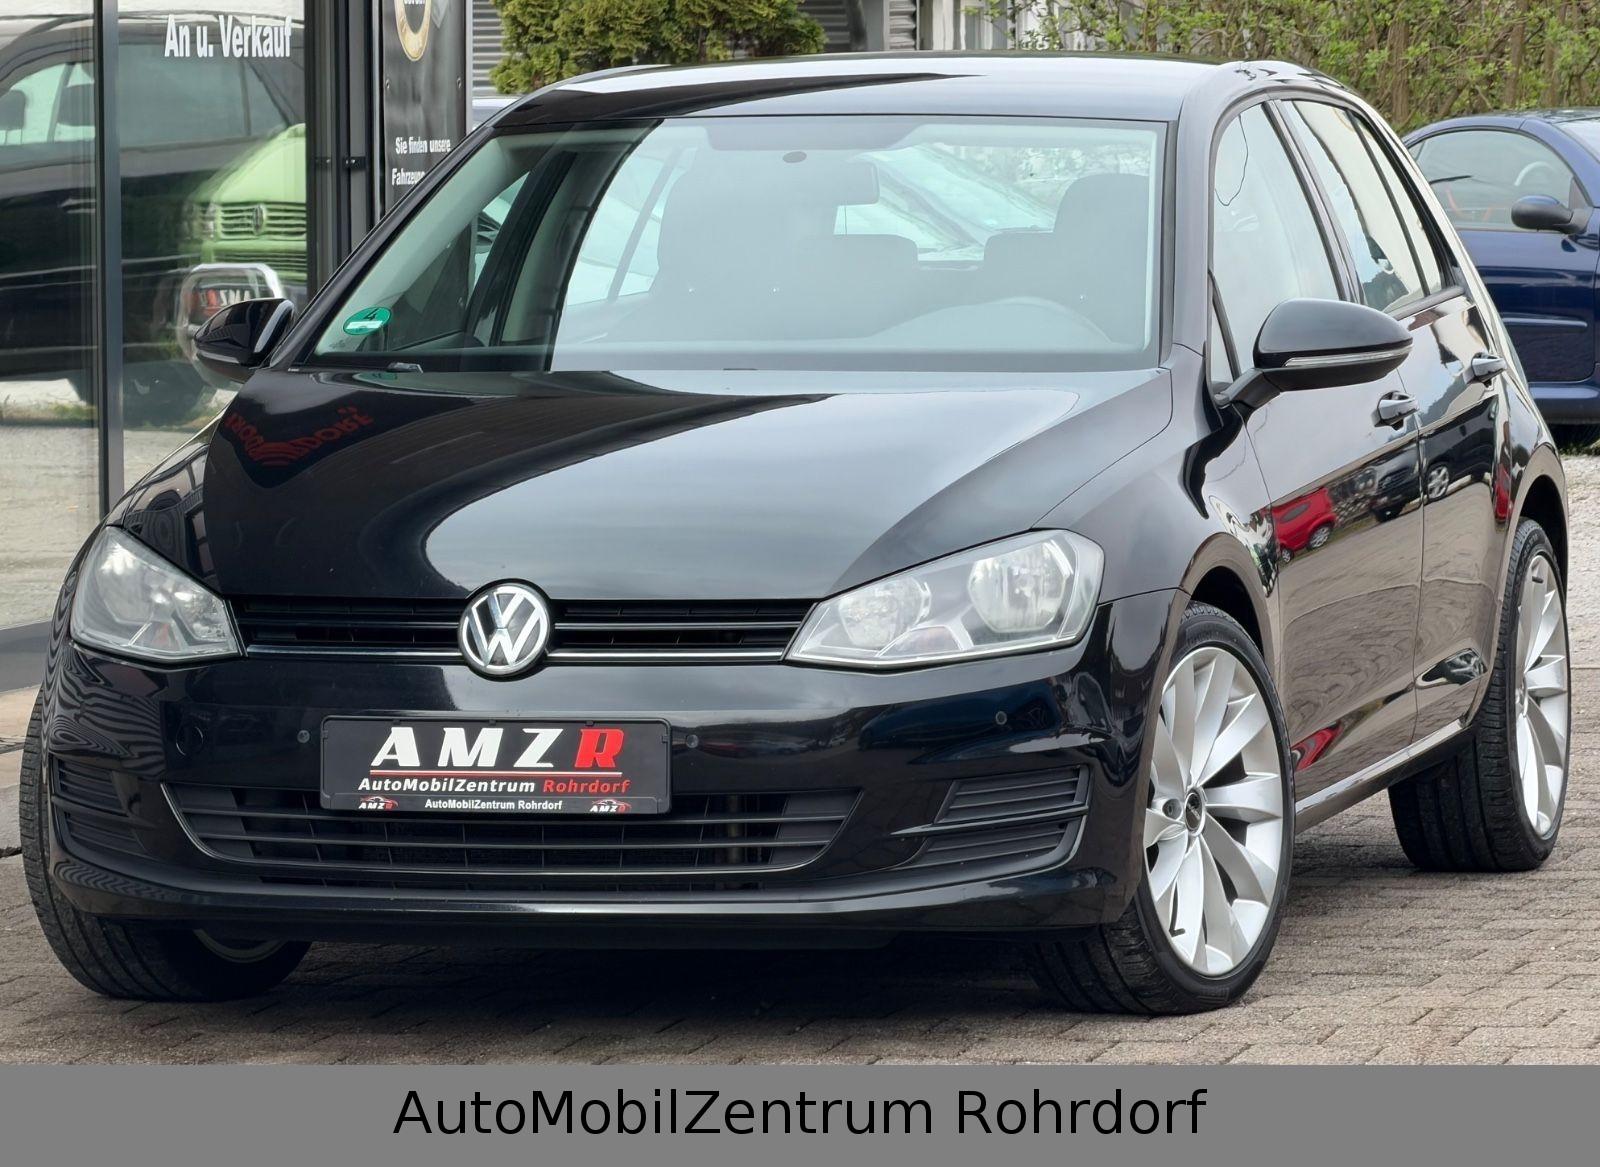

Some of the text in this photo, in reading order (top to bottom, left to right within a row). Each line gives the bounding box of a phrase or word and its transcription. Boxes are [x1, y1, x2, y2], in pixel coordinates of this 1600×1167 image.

[164, 14, 292, 58] An u. Verkauf
[395, 136, 451, 154] Sie finden unsere
[358, 778, 630, 793] AutoMobilZentrum Rohrdorf
[424, 798, 562, 811] AutoMobilZentrum Rohrdorf
